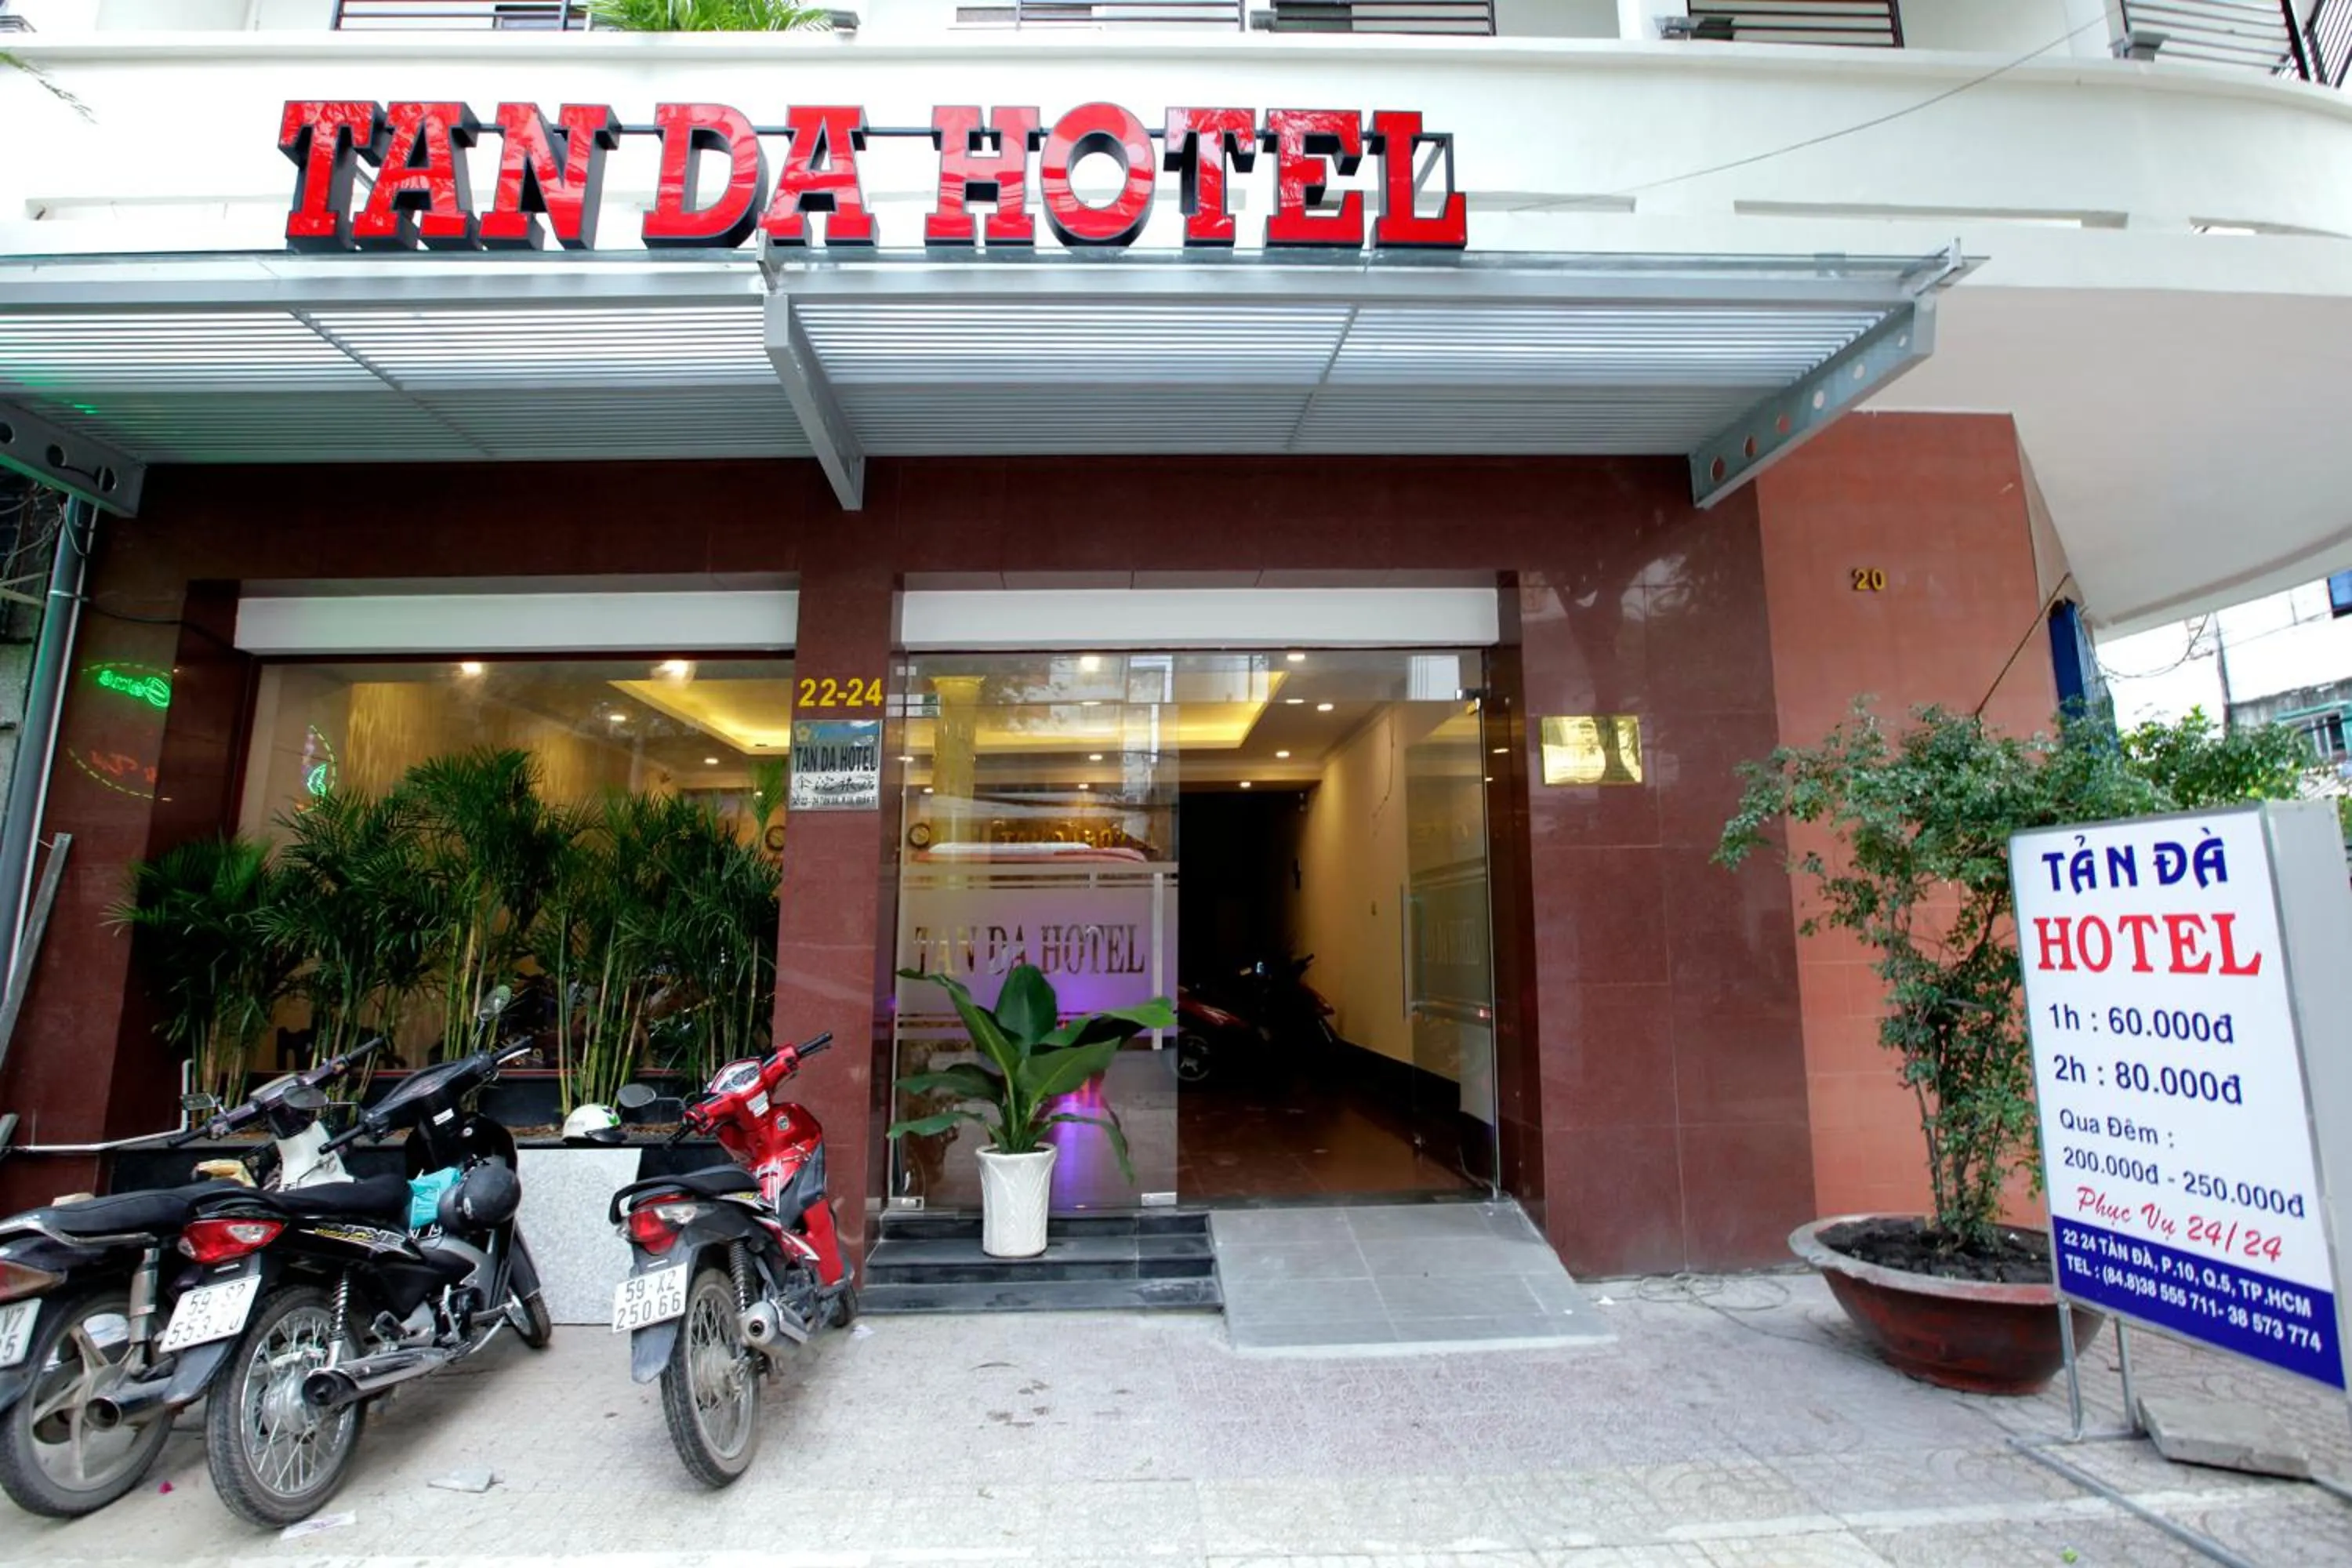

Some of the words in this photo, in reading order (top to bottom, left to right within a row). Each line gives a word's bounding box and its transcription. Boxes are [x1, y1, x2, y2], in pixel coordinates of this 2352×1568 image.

[278, 100, 620, 250] TAN
[641, 102, 878, 249] DA
[925, 101, 1468, 248] HOTEL
[1855, 569, 1886, 590] 20
[798, 677, 884, 707] 22-24
[795, 746, 818, 772] TAN
[821, 746, 836, 772] DA
[840, 746, 877, 772] HOTEL
[2042, 836, 2138, 895] TẢN
[2153, 827, 2228, 889] ĐÀ
[915, 926, 978, 975] TAN
[986, 924, 1027, 975] DA
[1041, 924, 1145, 975] HOTEL
[2033, 913, 2262, 976] HOTEL
[2049, 1004, 2080, 1030] 1h
[2109, 1007, 2234, 1044] 60.000đ
[2054, 1054, 2086, 1083] 2h
[2115, 1061, 2242, 1105] 80.000đ
[2060, 1109, 2100, 1134] Qua
[2107, 1116, 2158, 1145] Đêm
[2063, 1146, 2159, 1186] 200.000đ
[2183, 1171, 2305, 1219] 250.000đ
[2063, 1228, 2079, 1247] 22
[2081, 1232, 2096, 1252] 24
[2077, 1186, 2132, 1227] Phục
[2141, 1203, 2176, 1241] Vụ
[2187, 1215, 2282, 1264] 24/24
[2160, 1283, 2187, 1308] 555
[2227, 1305, 2249, 1329] 38
[2252, 1312, 2284, 1341] 573
[2287, 1323, 2322, 1354] 774
